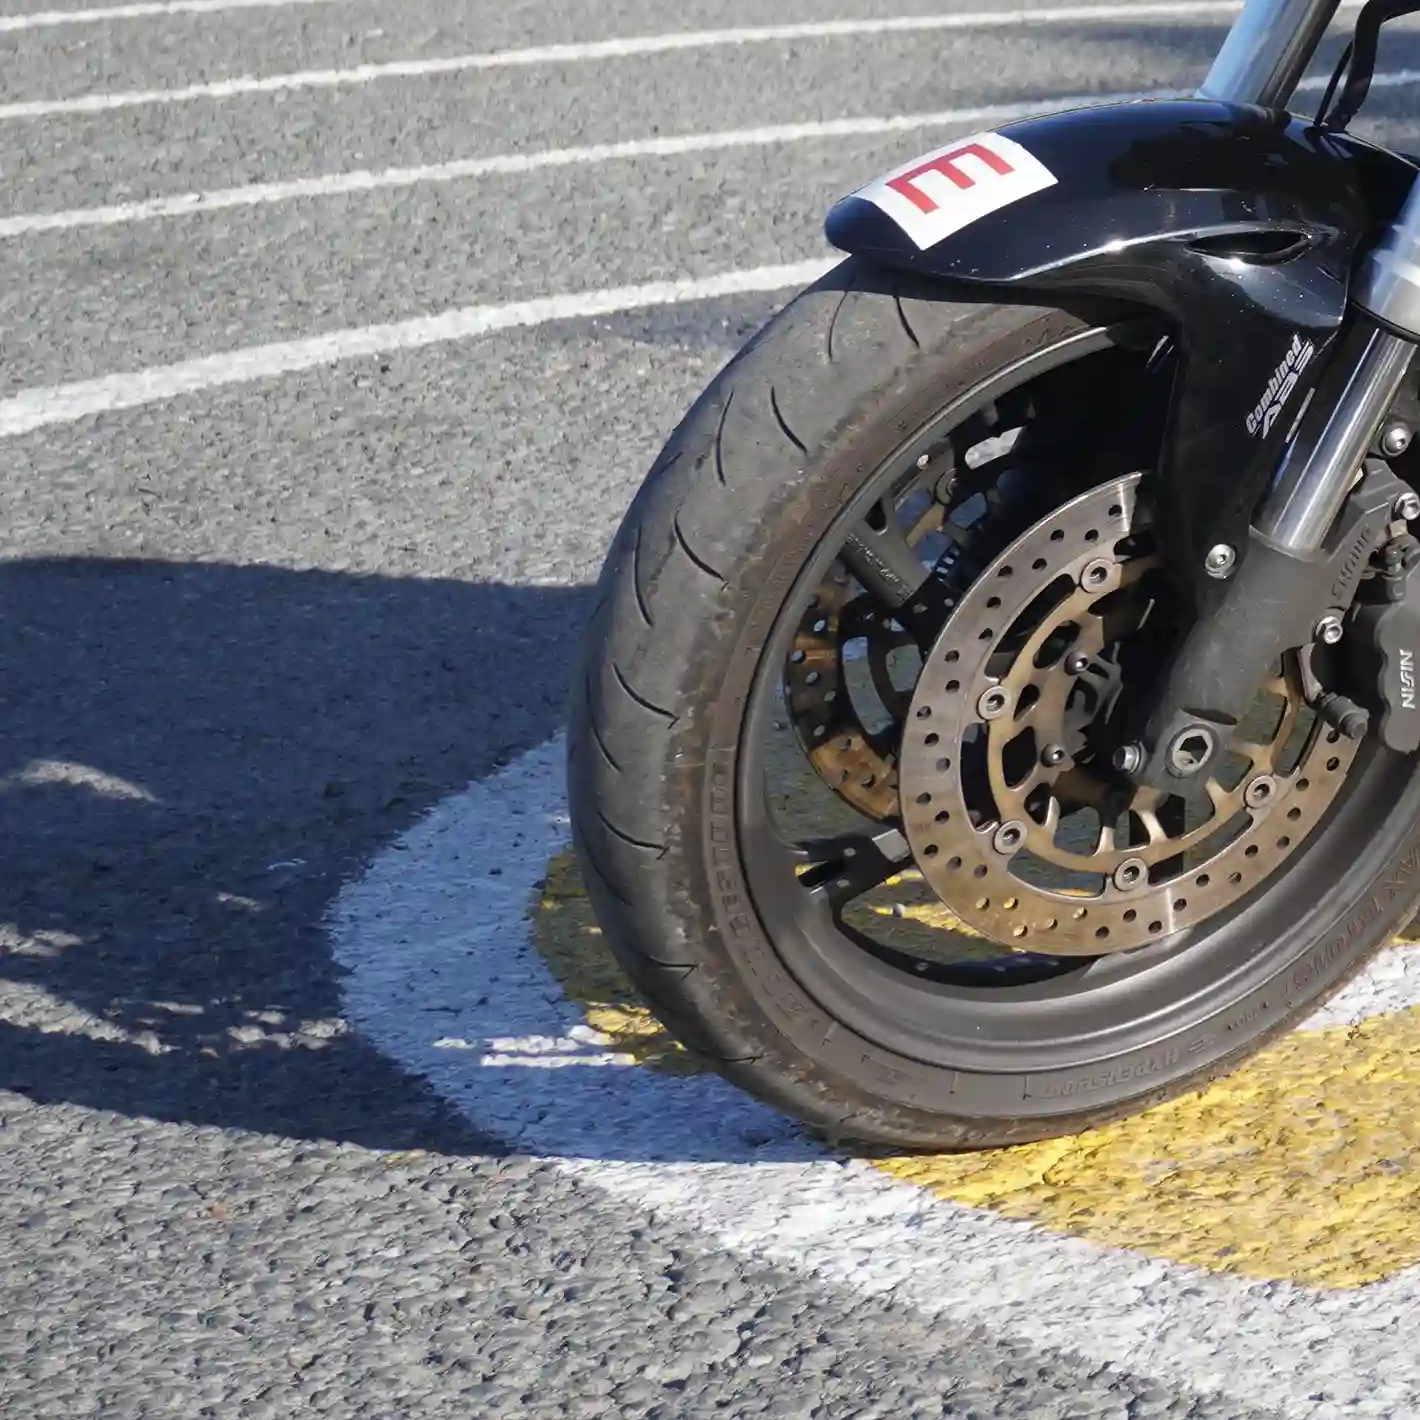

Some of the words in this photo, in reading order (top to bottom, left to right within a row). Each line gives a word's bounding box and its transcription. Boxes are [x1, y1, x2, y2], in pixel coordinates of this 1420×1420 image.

[1245, 333, 1303, 434] Combined
[1261, 339, 1315, 440] ABS
[1399, 648, 1416, 710] NISSIN
